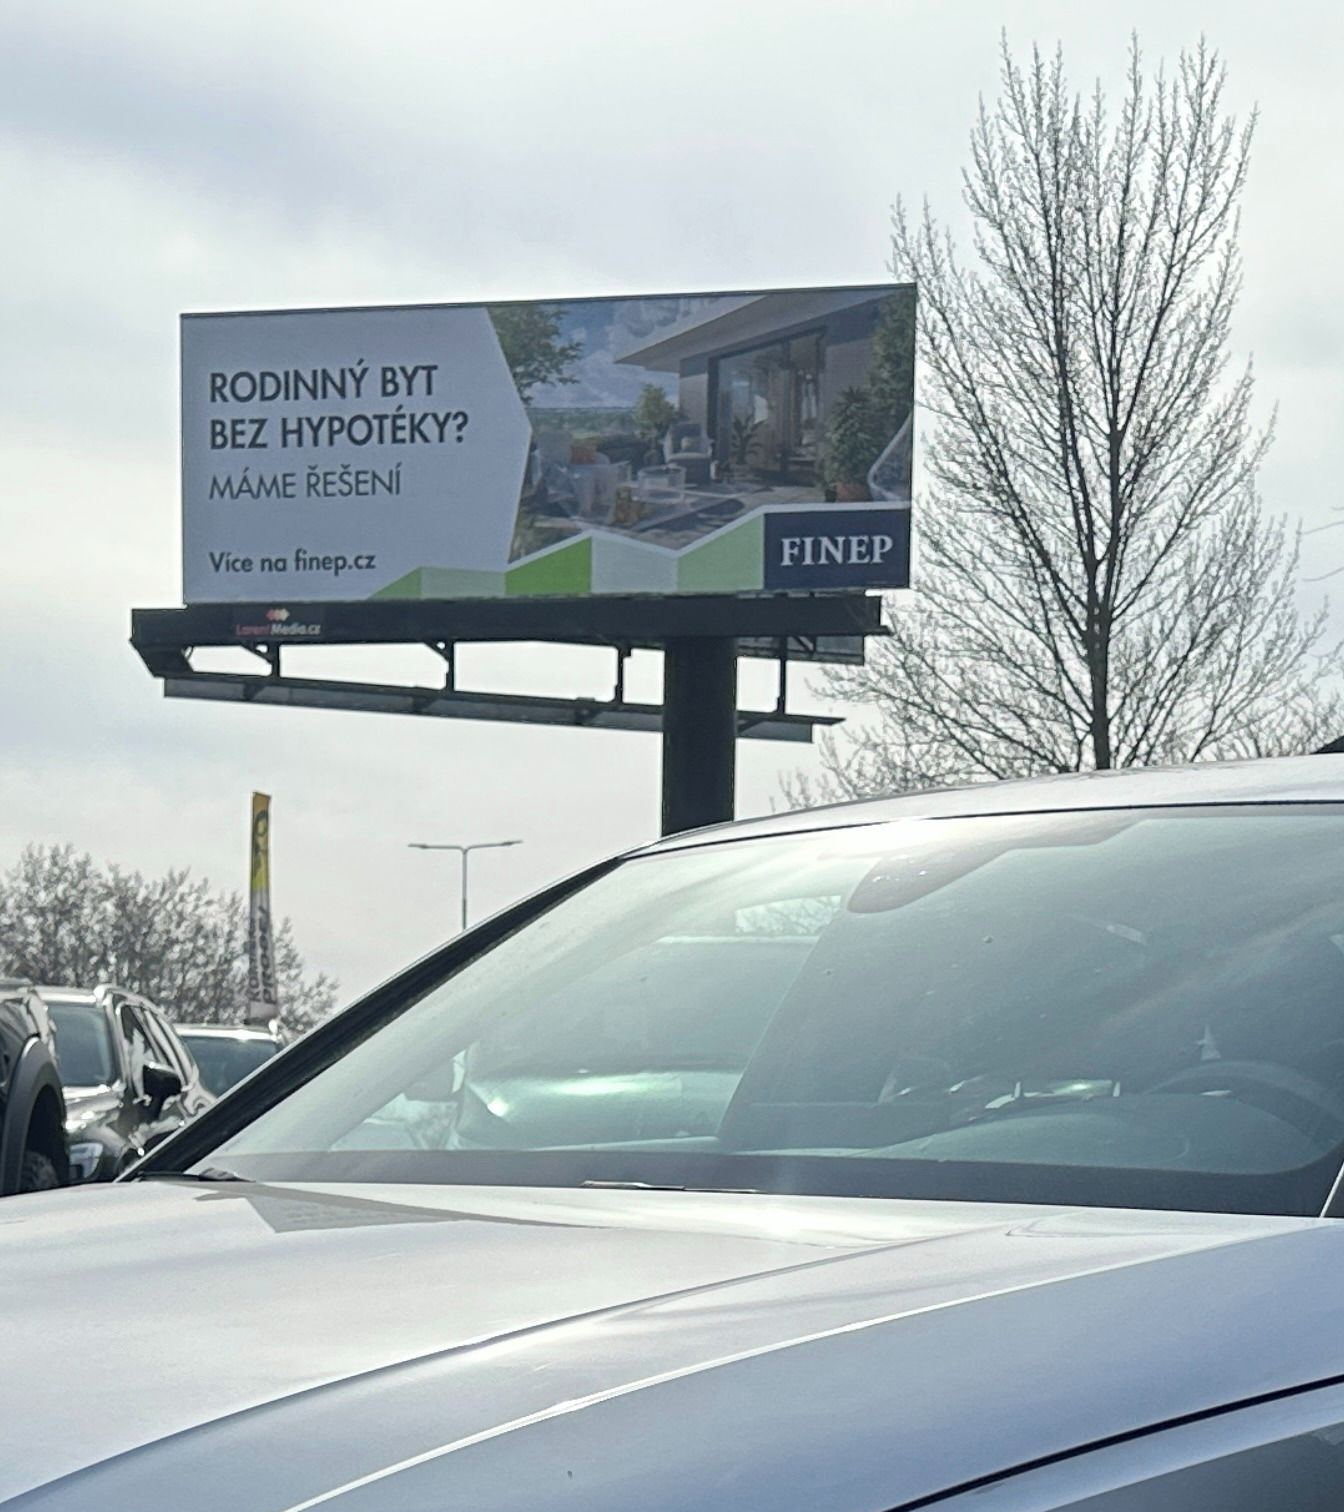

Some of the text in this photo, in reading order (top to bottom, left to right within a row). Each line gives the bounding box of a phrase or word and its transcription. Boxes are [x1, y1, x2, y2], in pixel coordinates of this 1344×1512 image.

[209, 358, 438, 403] RODINNÝ BYT
[210, 404, 469, 450] BEZ HYPOTÉKY?
[209, 462, 402, 500] MÁME ŘEŠENÍ
[209, 548, 377, 577] Více na finep.cz
[780, 535, 894, 567] FINEP
